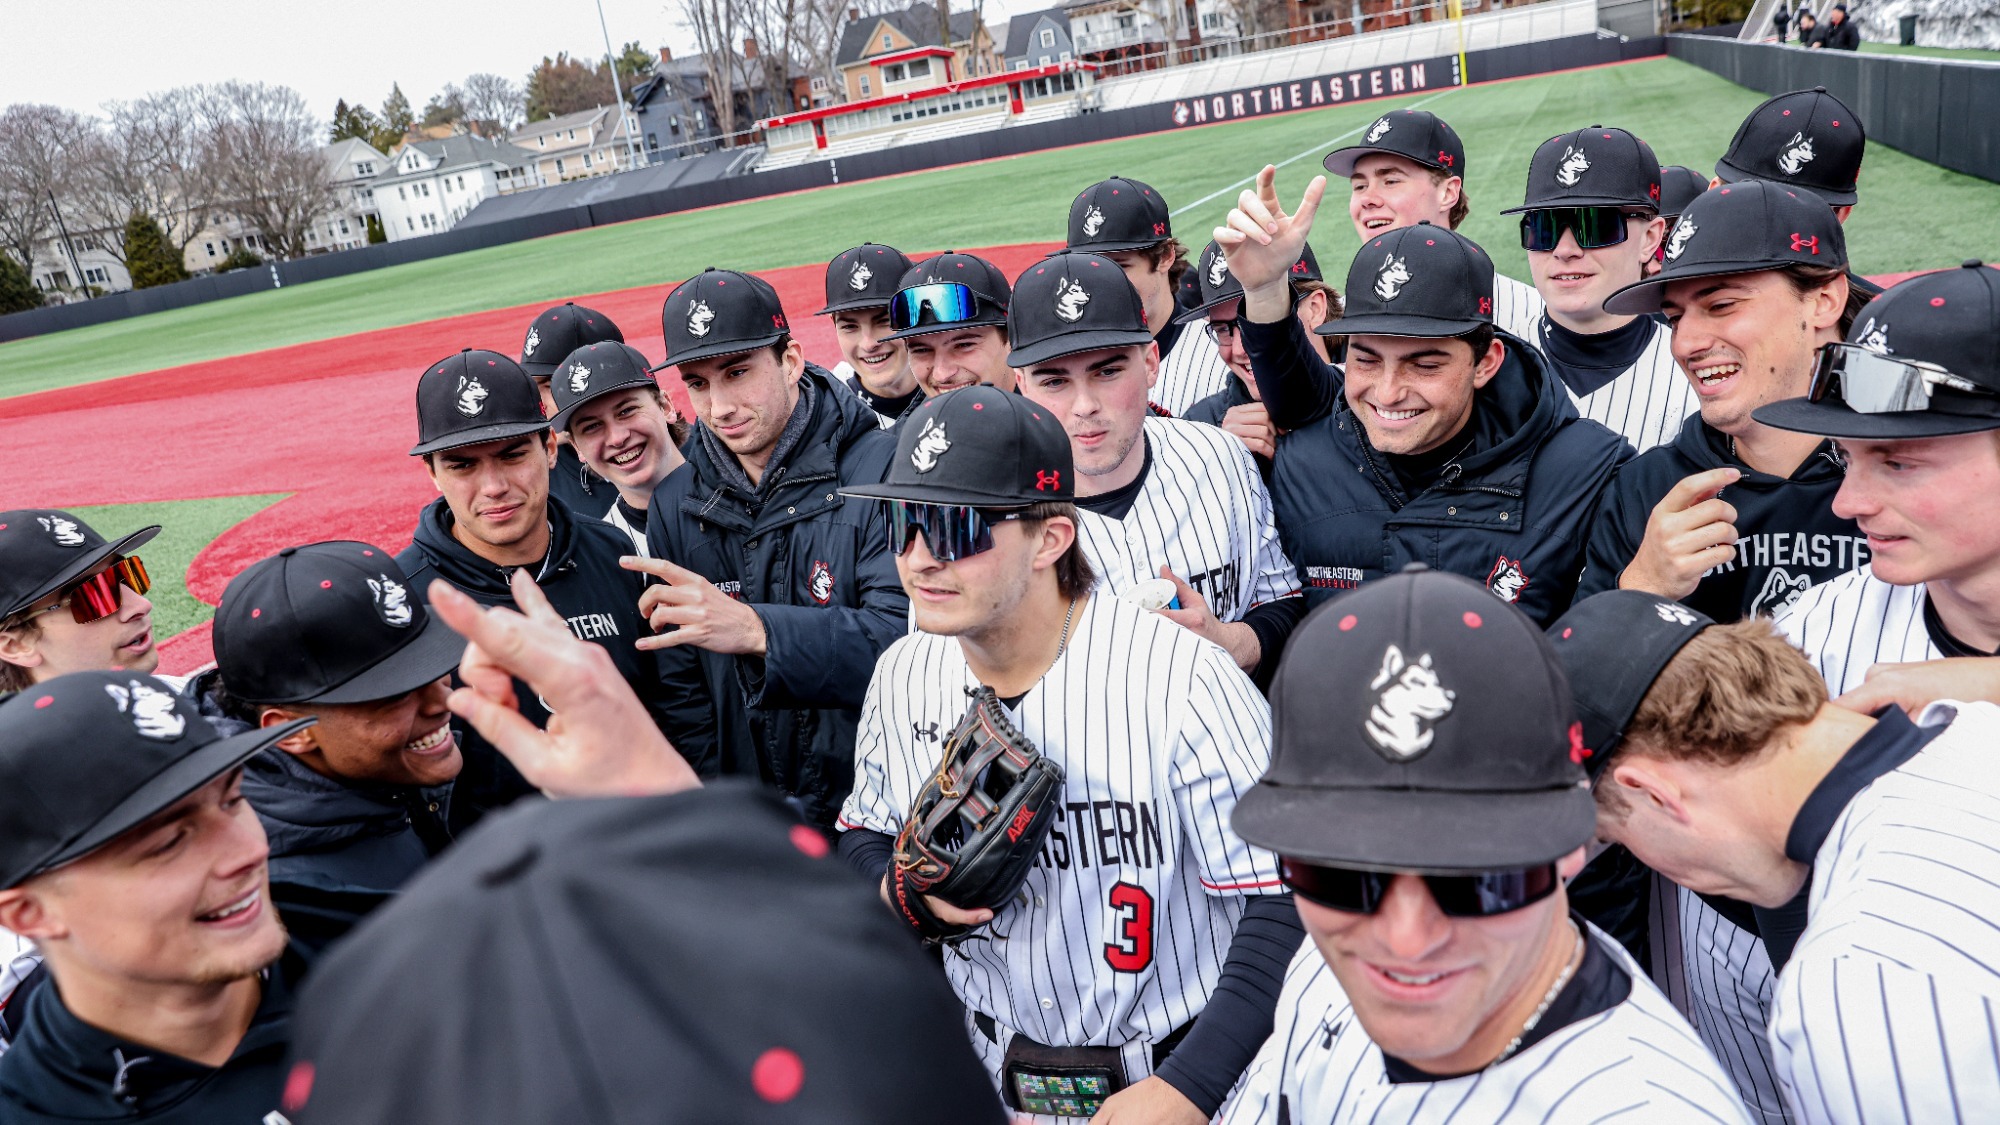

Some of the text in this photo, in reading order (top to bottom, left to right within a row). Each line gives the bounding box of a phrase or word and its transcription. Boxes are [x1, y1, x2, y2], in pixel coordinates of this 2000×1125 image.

[1193, 63, 1426, 123] NORTHEASTERN
[1306, 565, 1364, 581] NORTHEASTERN
[1701, 532, 1868, 578] THEASTE
[1311, 577, 1358, 591] BASEBALL
[562, 612, 620, 640] TERN
[1007, 803, 1036, 844] A2K
[1103, 880, 1154, 974] 3
